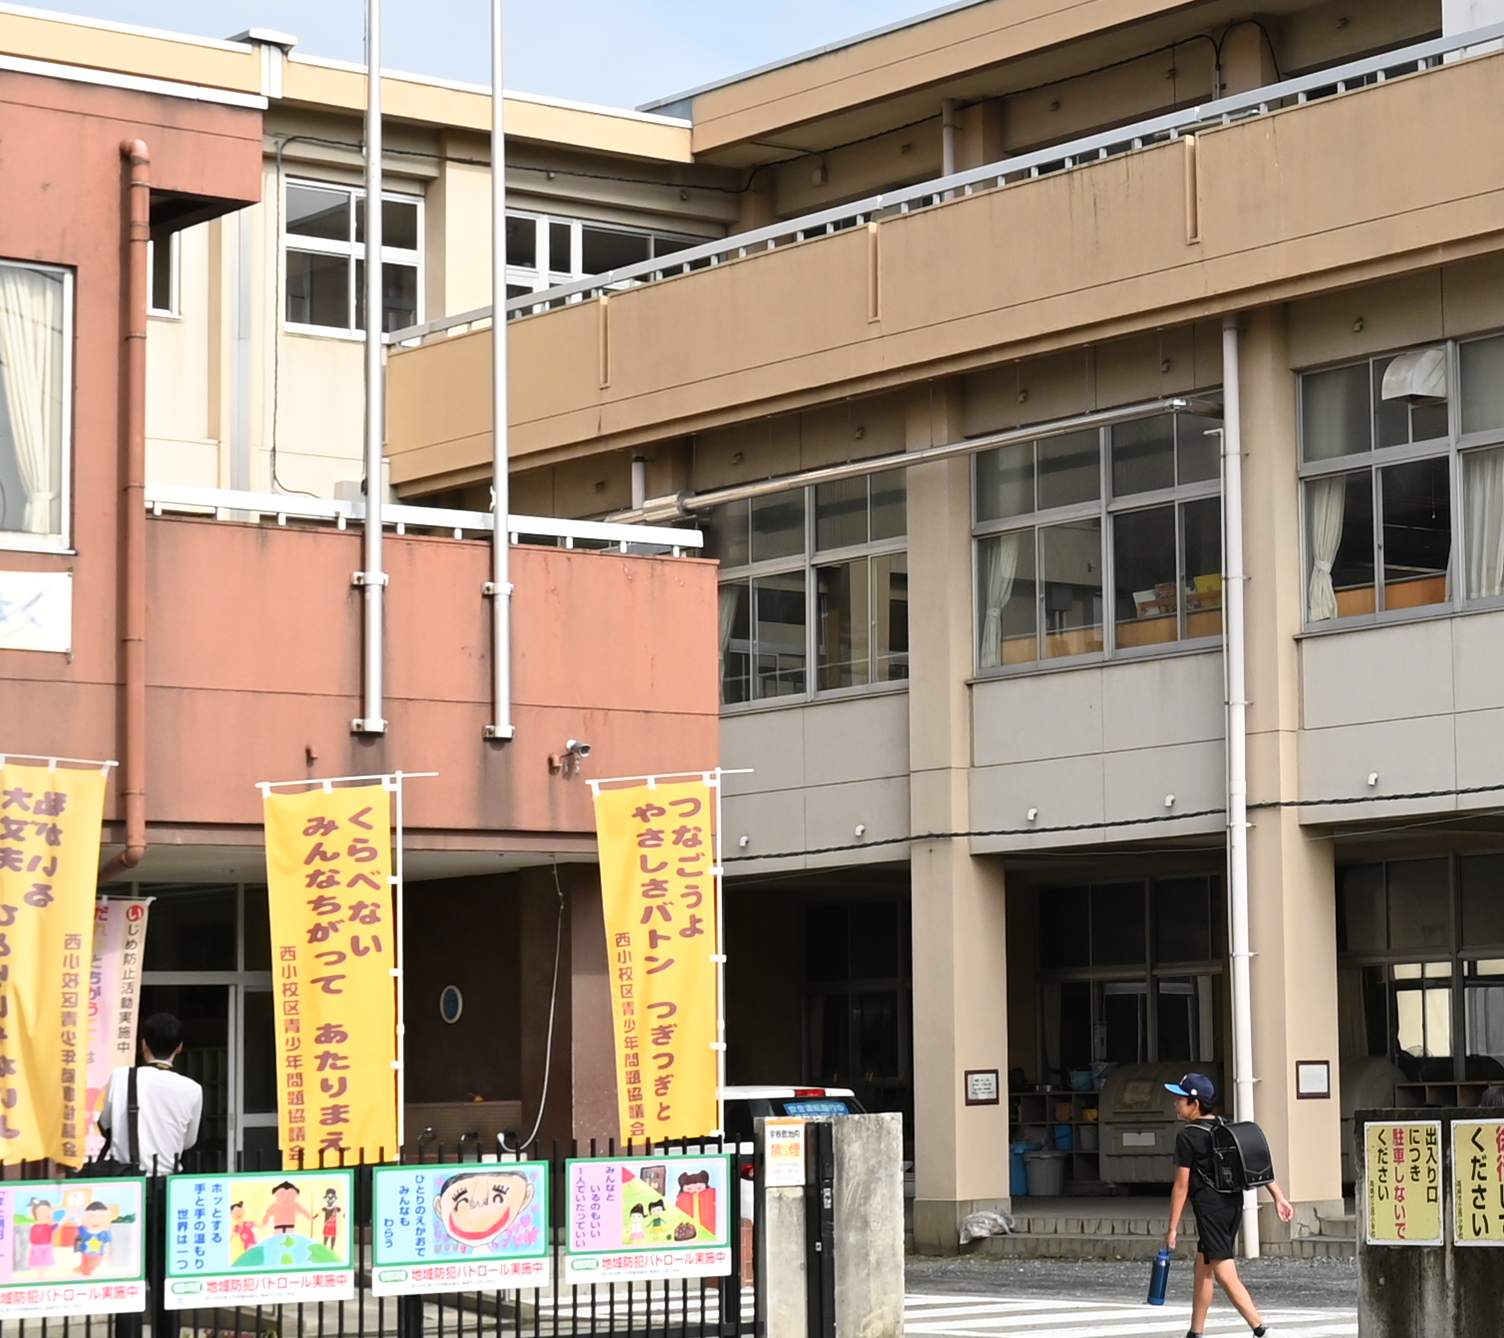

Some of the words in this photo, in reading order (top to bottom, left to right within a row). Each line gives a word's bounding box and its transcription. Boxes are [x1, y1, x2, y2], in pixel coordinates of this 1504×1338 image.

[303, 816, 347, 995] みんなちがって
[346, 806, 383, 957] くらべない
[631, 802, 675, 975] やさしさバトン
[668, 797, 705, 938] つなごうよ
[117, 904, 144, 1054] いじめ防止活動実施中
[280, 945, 306, 1161] 西小校区青少年問題協議会
[615, 932, 645, 1136] 西小校区青少年問題協議会
[647, 1001, 677, 1122] つぎつぎと
[313, 1022, 351, 1152] あたりまえ
[605, 1166, 615, 1201] みんなと
[1377, 1128, 1389, 1201] ください
[1393, 1128, 1406, 1239] 駐車しないで
[1409, 1128, 1421, 1182] につき
[1426, 1127, 1438, 1203] 出入り口
[1471, 1127, 1489, 1237] ください
[176, 1209, 188, 1270] 世界は一つ
[194, 1183, 206, 1269] 手と手の温もり
[211, 1183, 223, 1243] ホッとする
[383, 1218, 394, 1248] わらう
[398, 1185, 410, 1226] みんなも
[415, 1174, 426, 1256] ひとりのえがおで
[590, 1185, 600, 1238] いるのもいい
[206, 1274, 348, 1293] 地域防犯パトロール実施中
[411, 1262, 543, 1281] 地域防犯パトロール実施中
[601, 1252, 725, 1269] 地域防犯パトロール実施中
